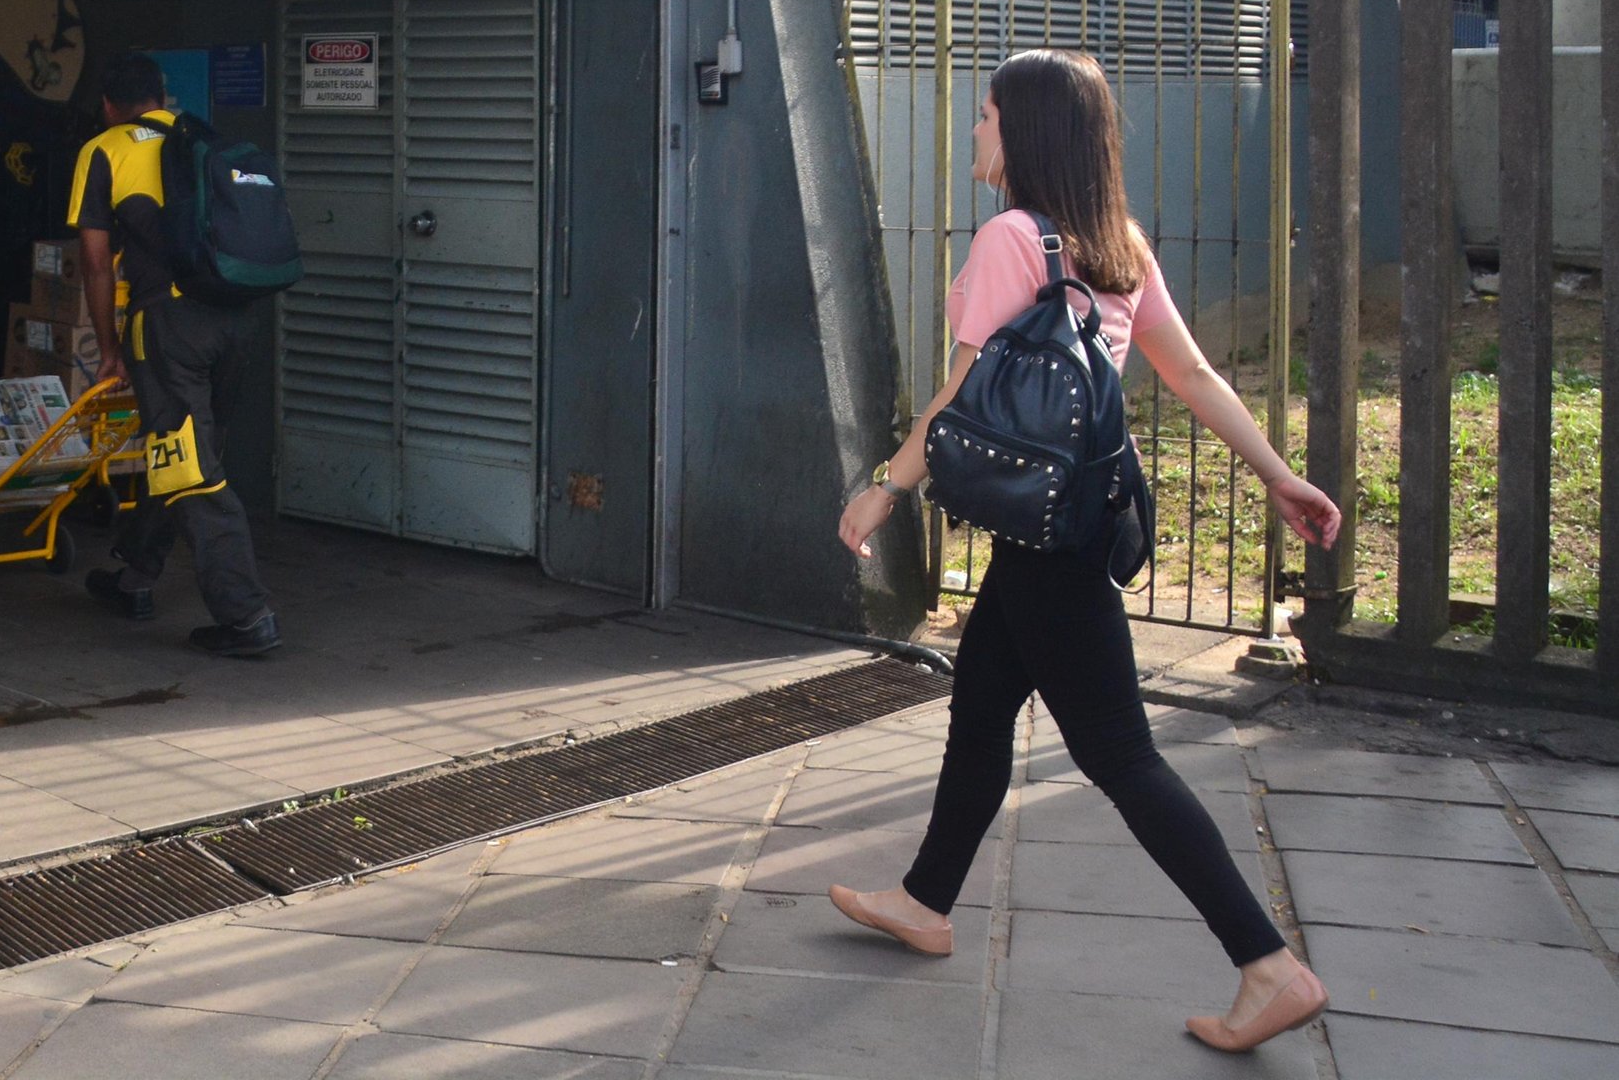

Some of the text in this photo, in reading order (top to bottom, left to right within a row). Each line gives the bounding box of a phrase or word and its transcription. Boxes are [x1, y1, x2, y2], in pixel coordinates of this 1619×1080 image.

[316, 44, 363, 58] PERIGO
[313, 67, 365, 77] ELETRICIDADE
[306, 79, 374, 89] SOMENTE PESSOAL
[316, 92, 363, 101] AUTORIZADO
